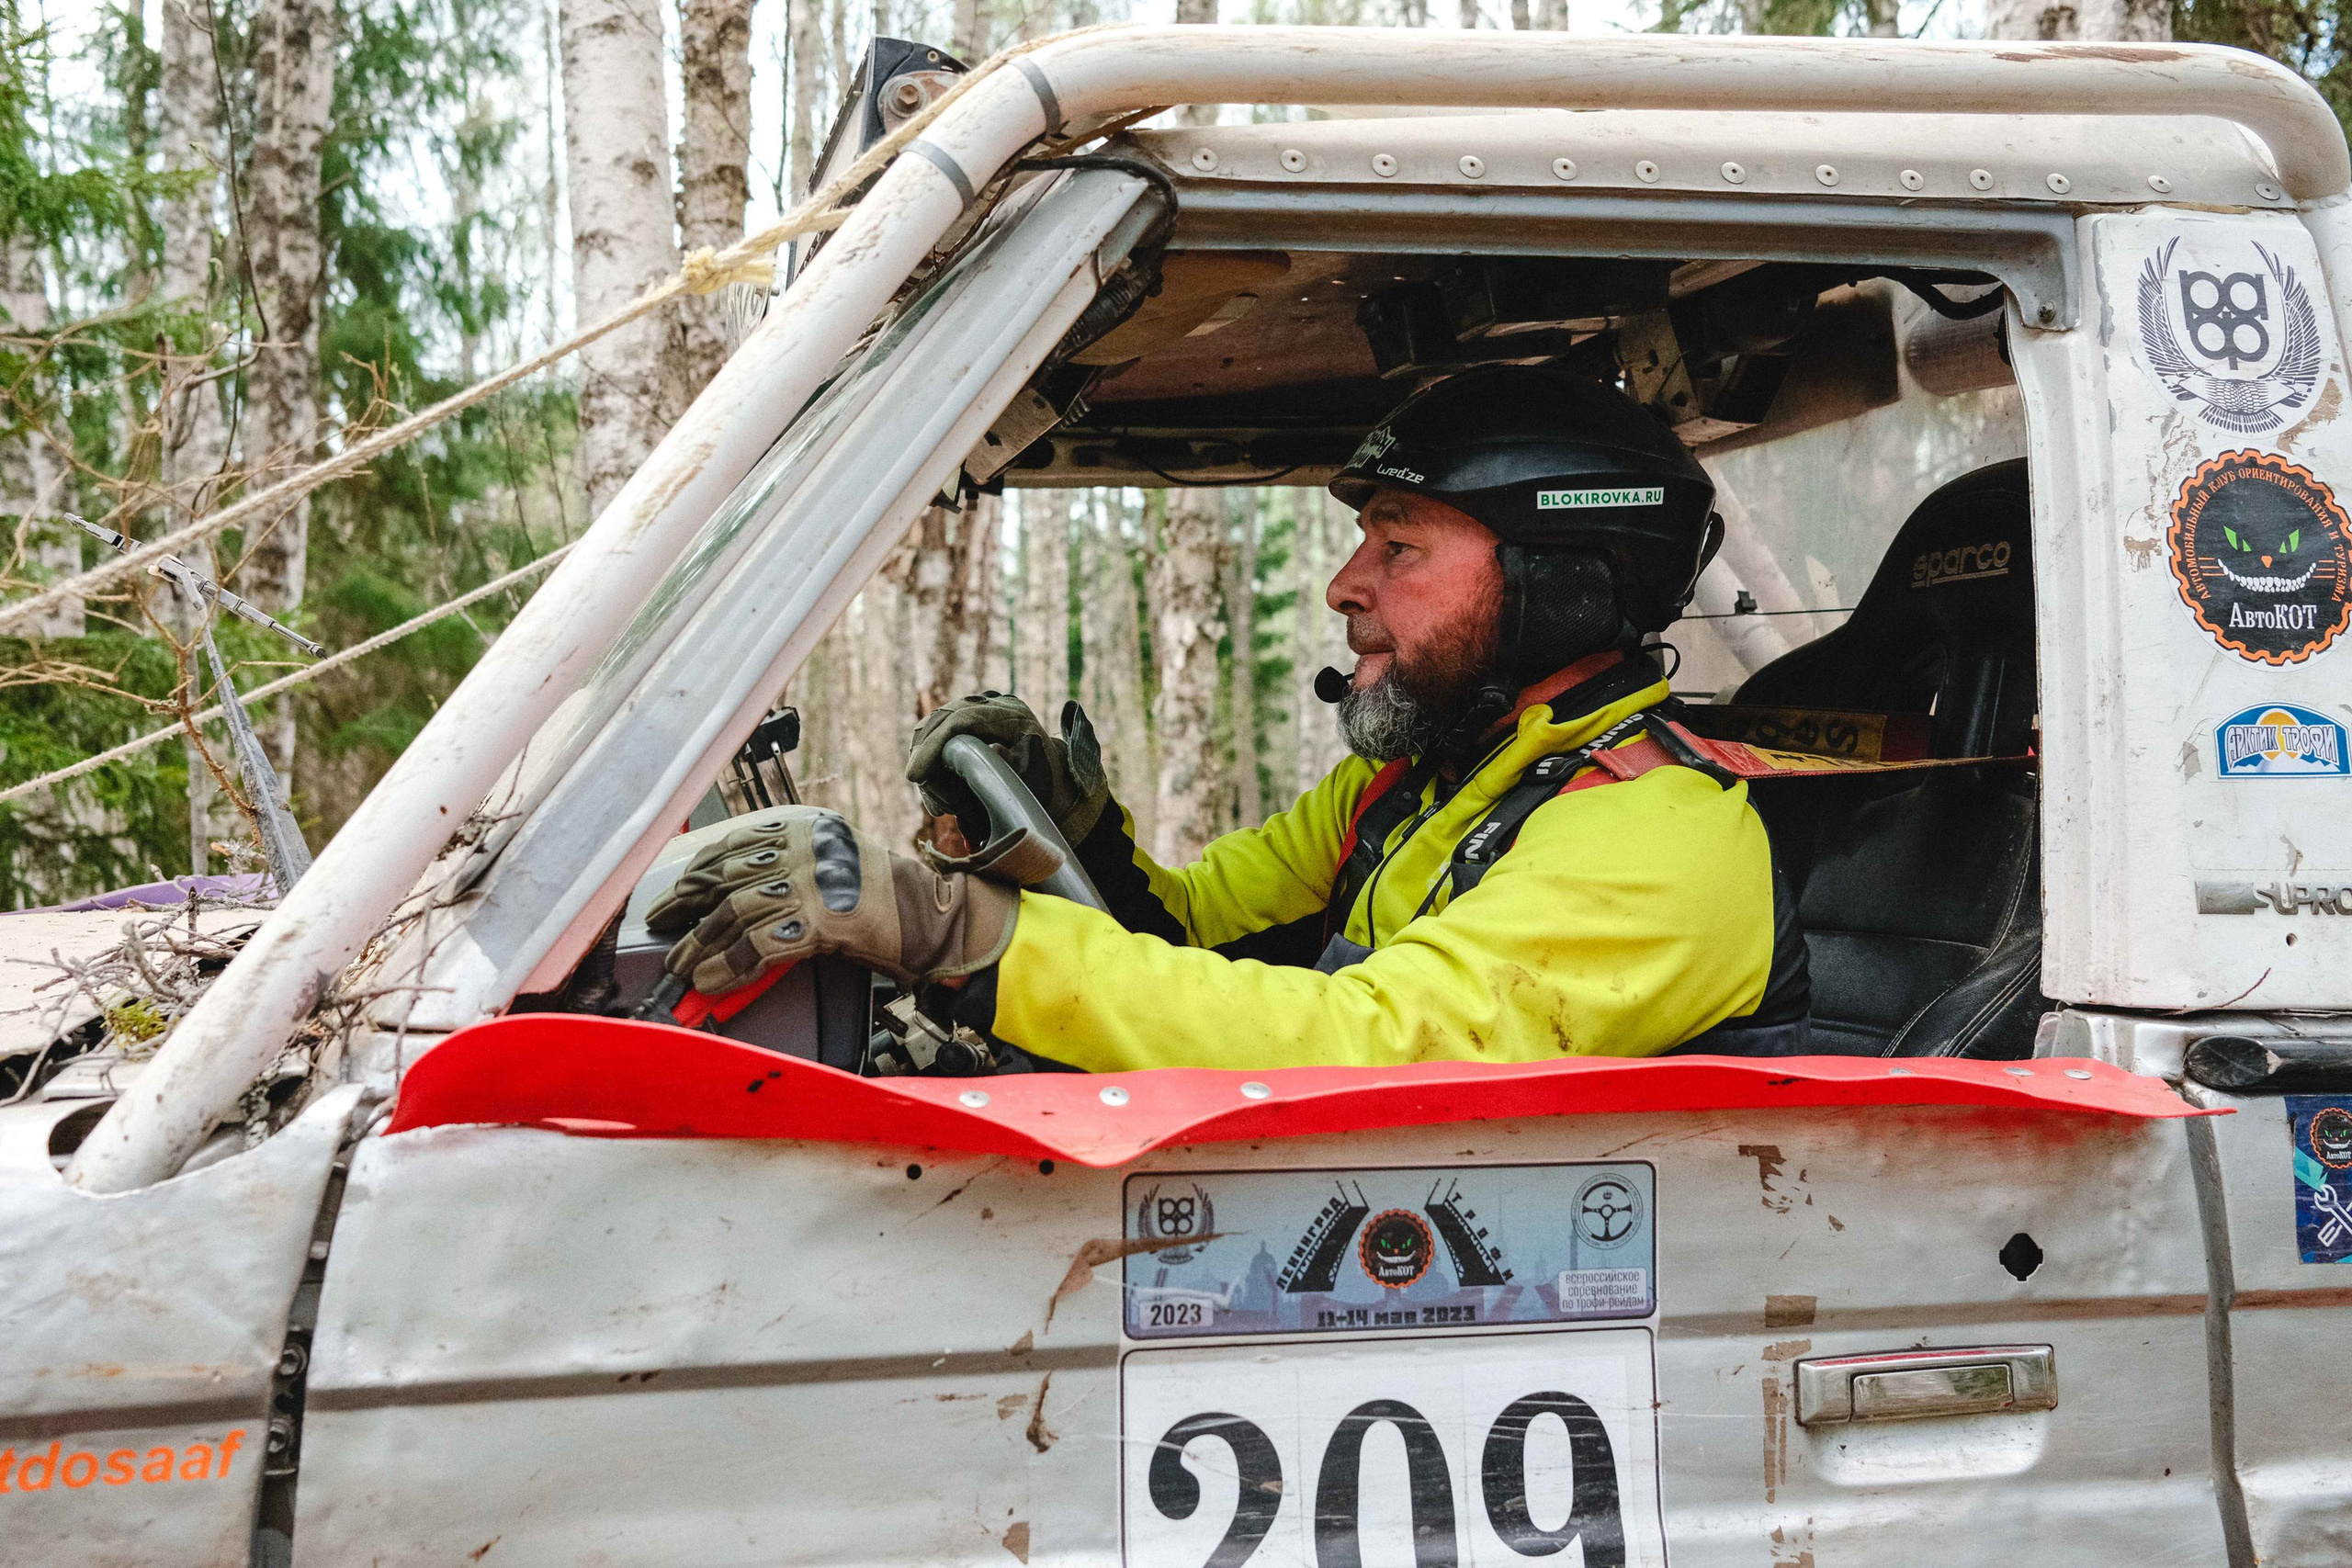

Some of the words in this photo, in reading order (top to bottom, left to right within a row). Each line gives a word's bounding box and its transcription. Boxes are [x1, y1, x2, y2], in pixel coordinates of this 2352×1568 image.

[1541, 488, 1662, 506] BLOKIROVKA.RU
[2208, 468, 2236, 493] КЛУБ
[2238, 467, 2334, 529] ОРИЕНТИРОВАНИЯ
[2184, 490, 2211, 600] АВТОМОБИЛЬНЫЙ
[2328, 530, 2339, 541] И
[1912, 540, 2011, 588] sparco
[2331, 544, 2347, 604] ТУРИЗМА
[2226, 725, 2278, 768] АРКТИК
[2281, 725, 2339, 764] ТРОФИ
[1276, 1196, 1343, 1291] ЛЕНИНГРАД
[1150, 1303, 1202, 1325] 2023
[1317, 1310, 1369, 1327] 11-14
[1423, 1305, 1476, 1323] 2023
[1148, 1391, 1626, 1568] 209
